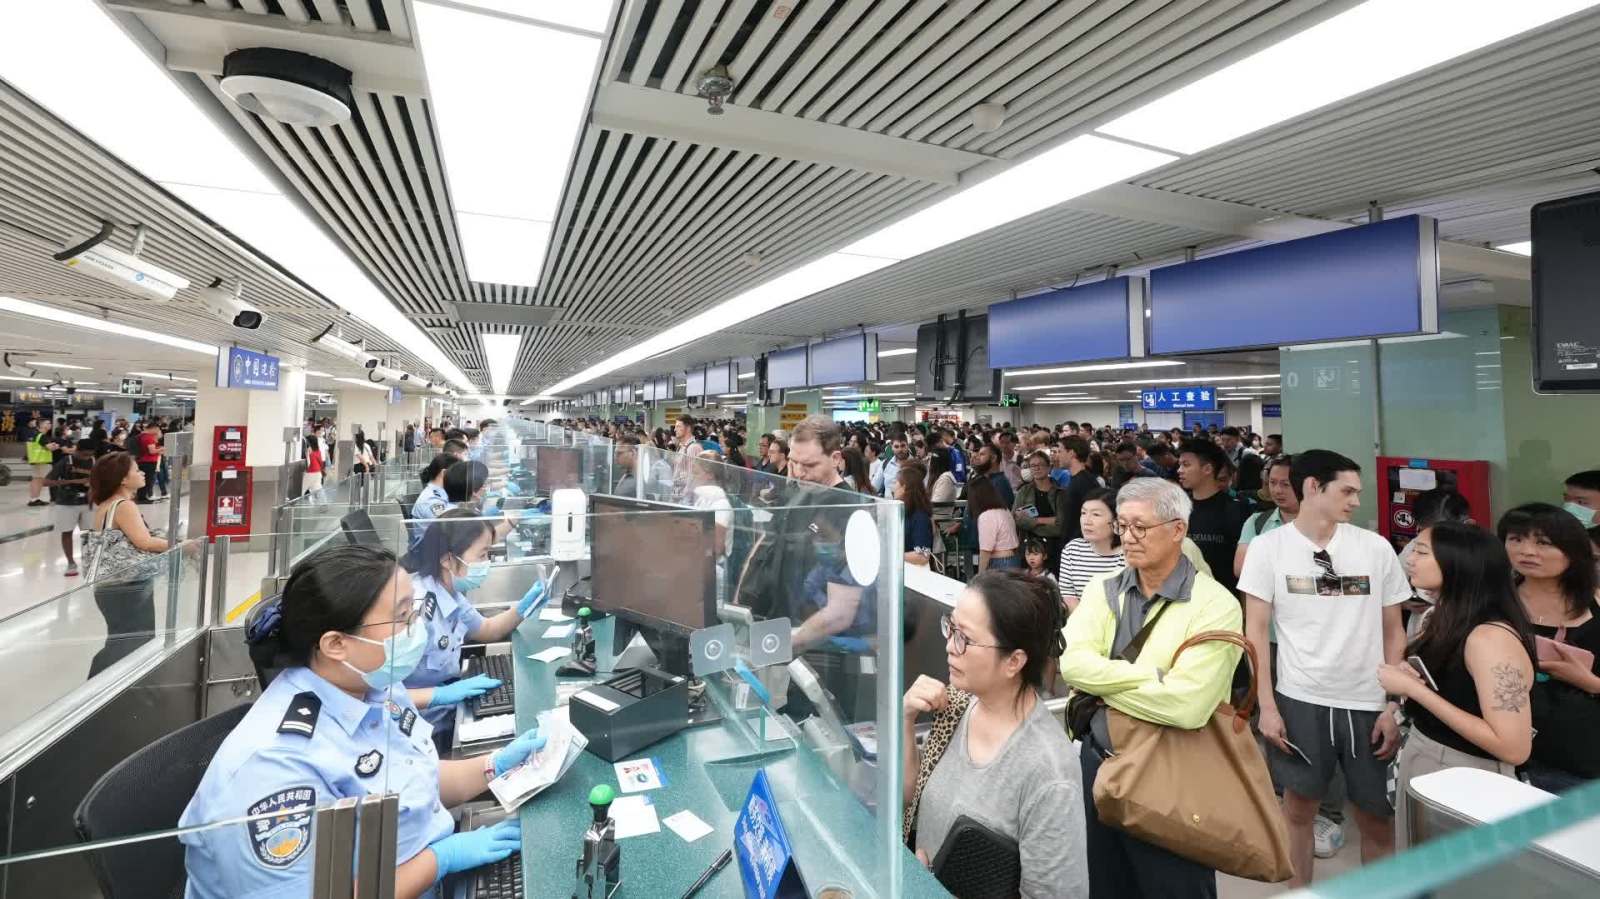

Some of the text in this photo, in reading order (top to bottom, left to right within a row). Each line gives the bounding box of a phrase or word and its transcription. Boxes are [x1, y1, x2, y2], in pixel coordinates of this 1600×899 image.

[1158, 391, 1210, 402] 人工查验
[251, 789, 312, 815] 中华人民共和国
